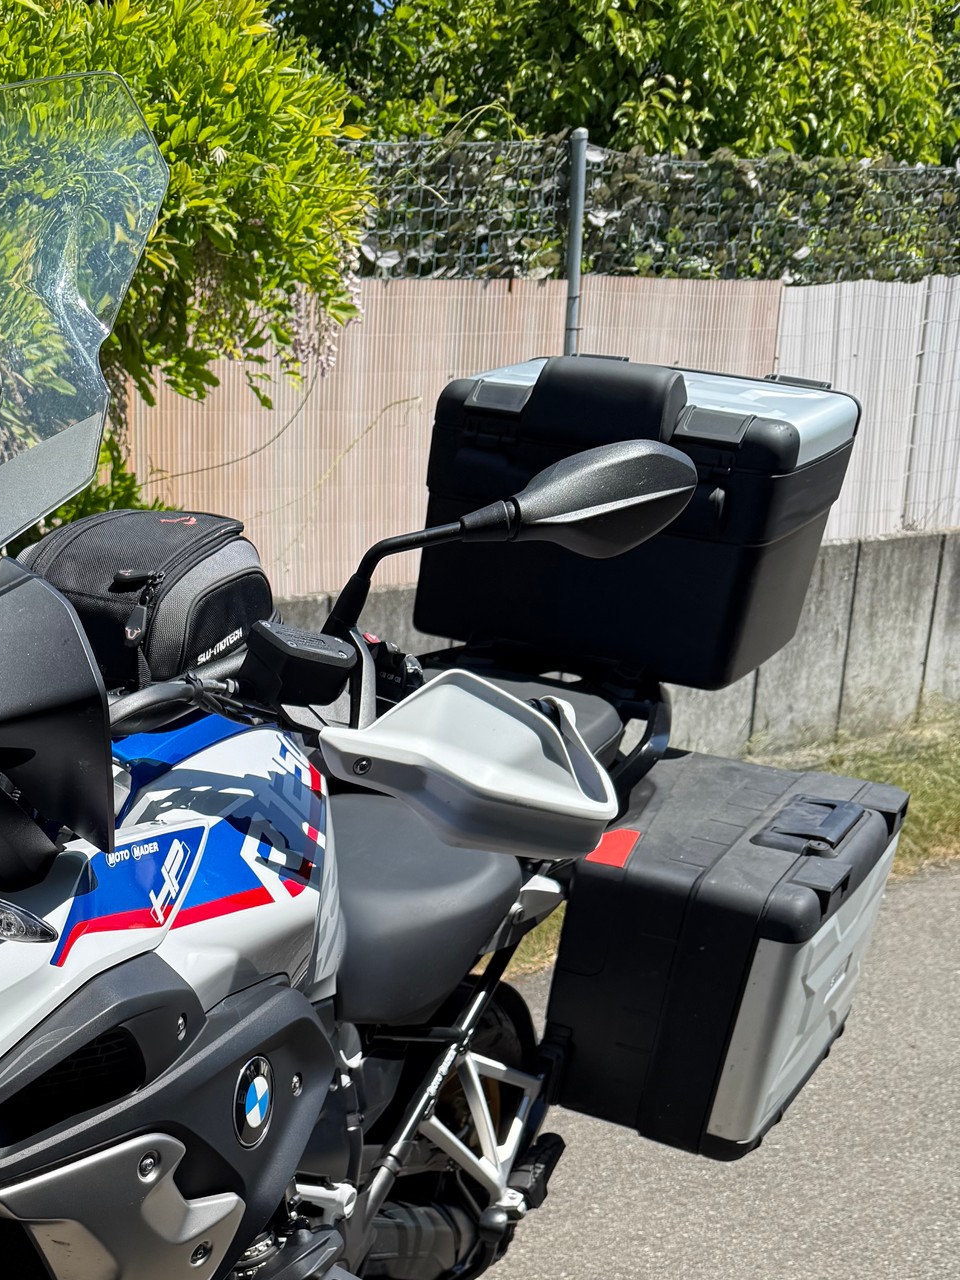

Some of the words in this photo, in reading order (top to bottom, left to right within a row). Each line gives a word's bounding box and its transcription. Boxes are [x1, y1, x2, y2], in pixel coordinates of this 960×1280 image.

[197, 628, 243, 665] SW-MOTECH
[106, 848, 130, 868] MOTO
[131, 841, 160, 860] MADER
[149, 838, 191, 925] HP
